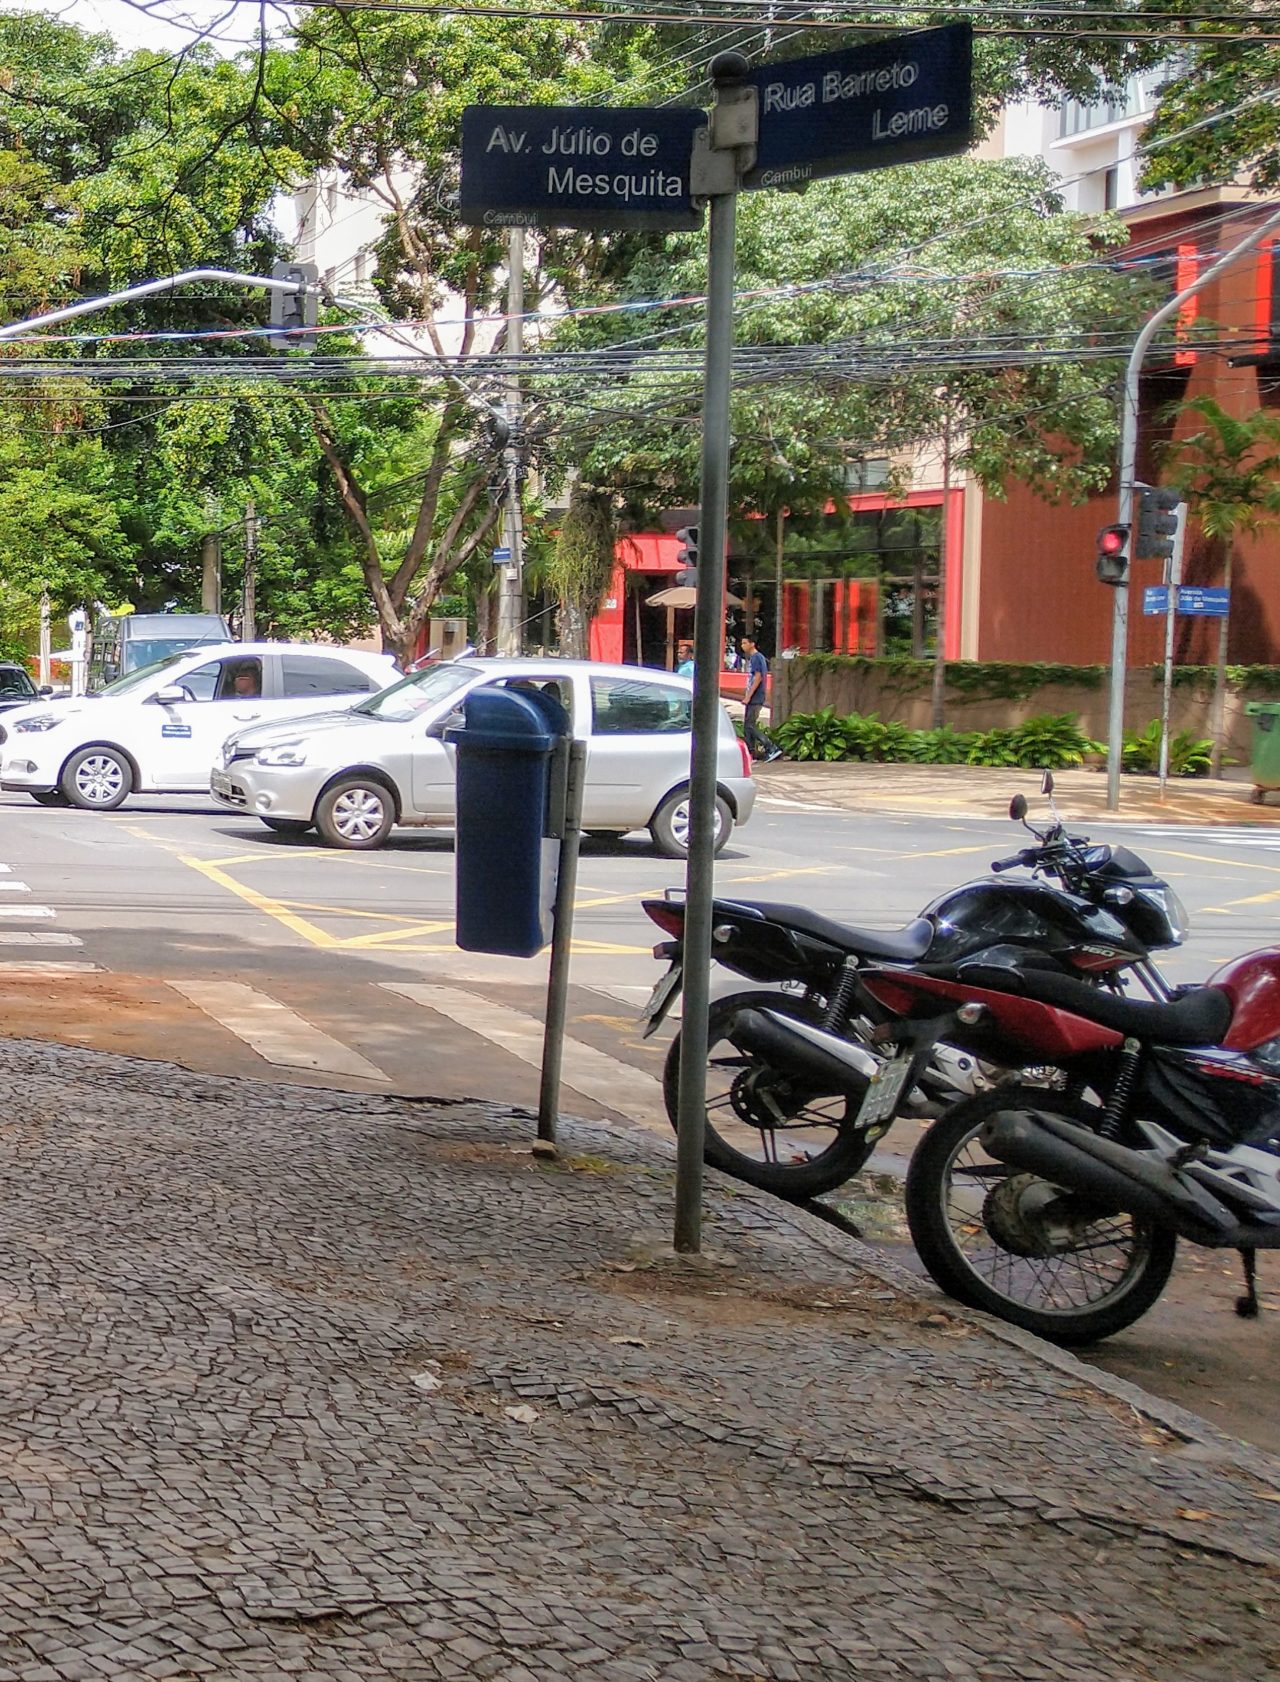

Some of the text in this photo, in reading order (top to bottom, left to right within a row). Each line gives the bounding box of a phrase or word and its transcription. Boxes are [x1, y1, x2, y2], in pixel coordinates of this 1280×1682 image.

[764, 61, 919, 115] Rua Barreto
[872, 104, 949, 140] Leme
[485, 124, 658, 156] Av. Júlio de
[547, 166, 682, 201] Mesquita
